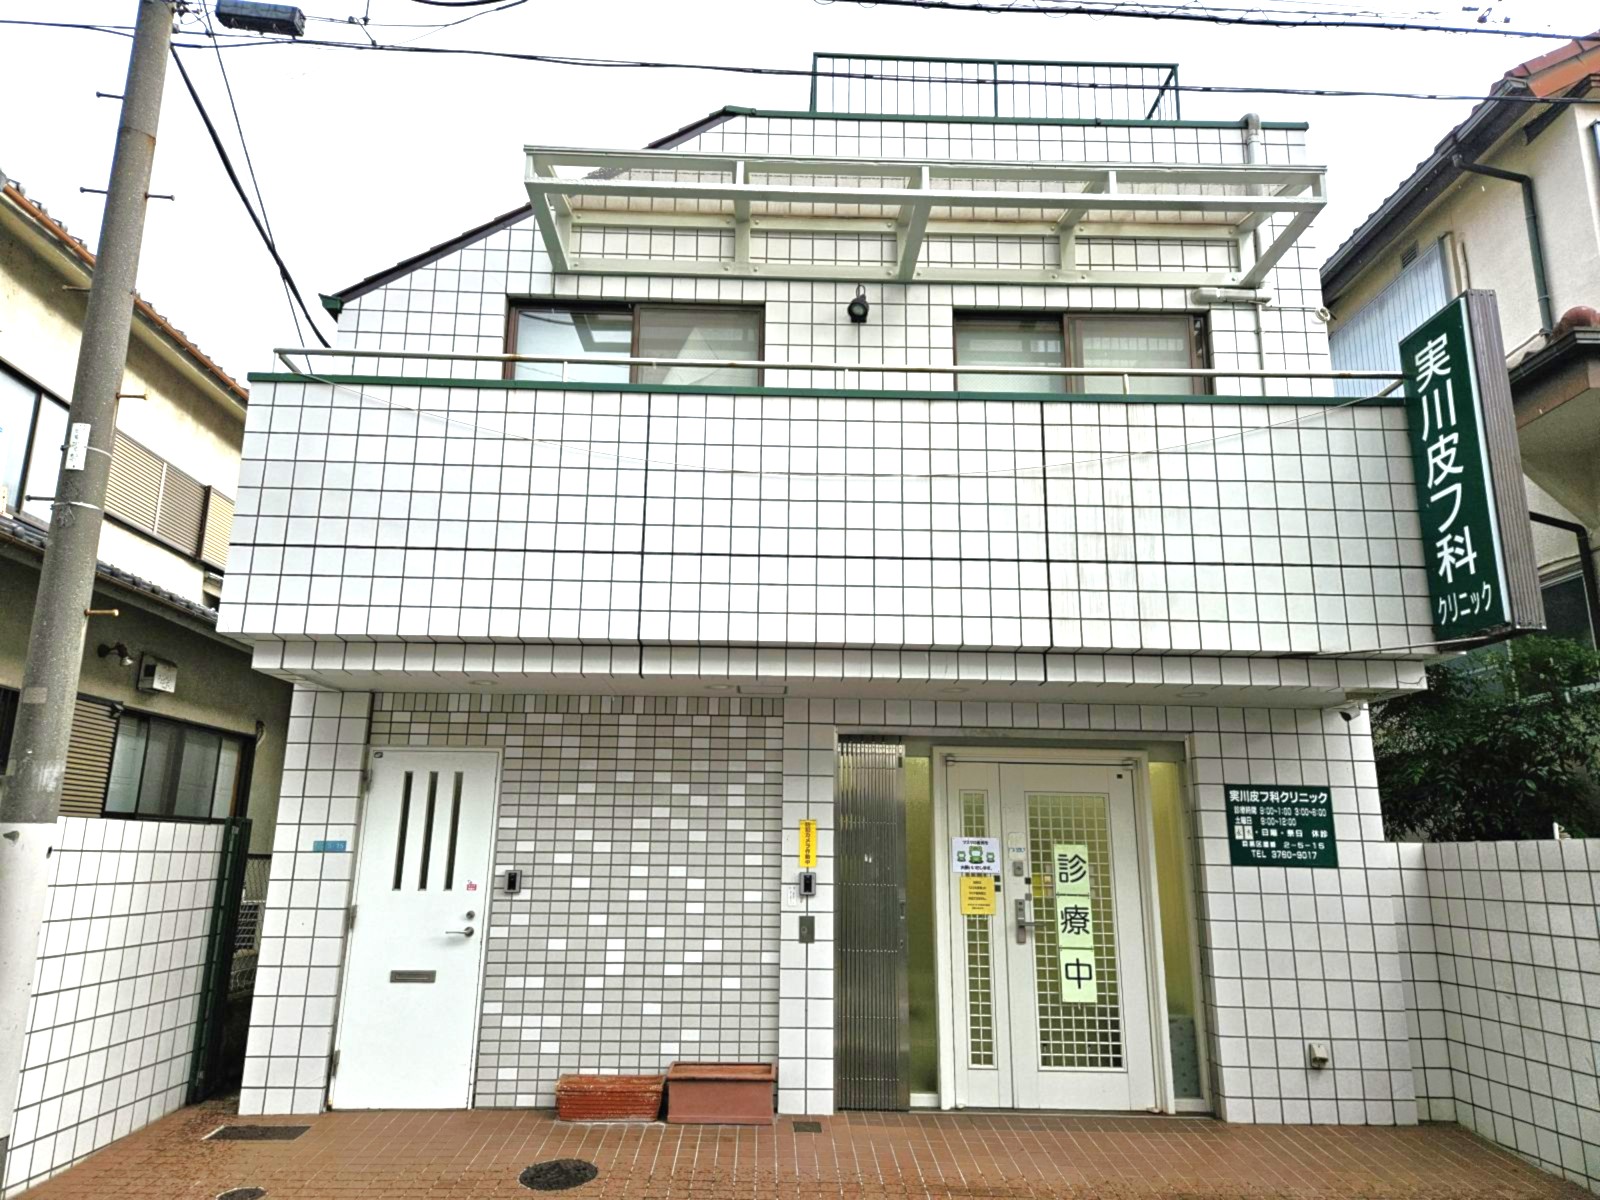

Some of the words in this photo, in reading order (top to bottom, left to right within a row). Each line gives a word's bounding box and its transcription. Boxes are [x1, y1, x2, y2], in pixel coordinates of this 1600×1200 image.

[1414, 332, 1478, 584] 実川皮フ科
[1437, 580, 1492, 626] クリニック
[1229, 790, 1328, 804] 実川皮フ科クリニック
[1251, 849, 1267, 858] TEL
[1057, 853, 1093, 990] 診療中
